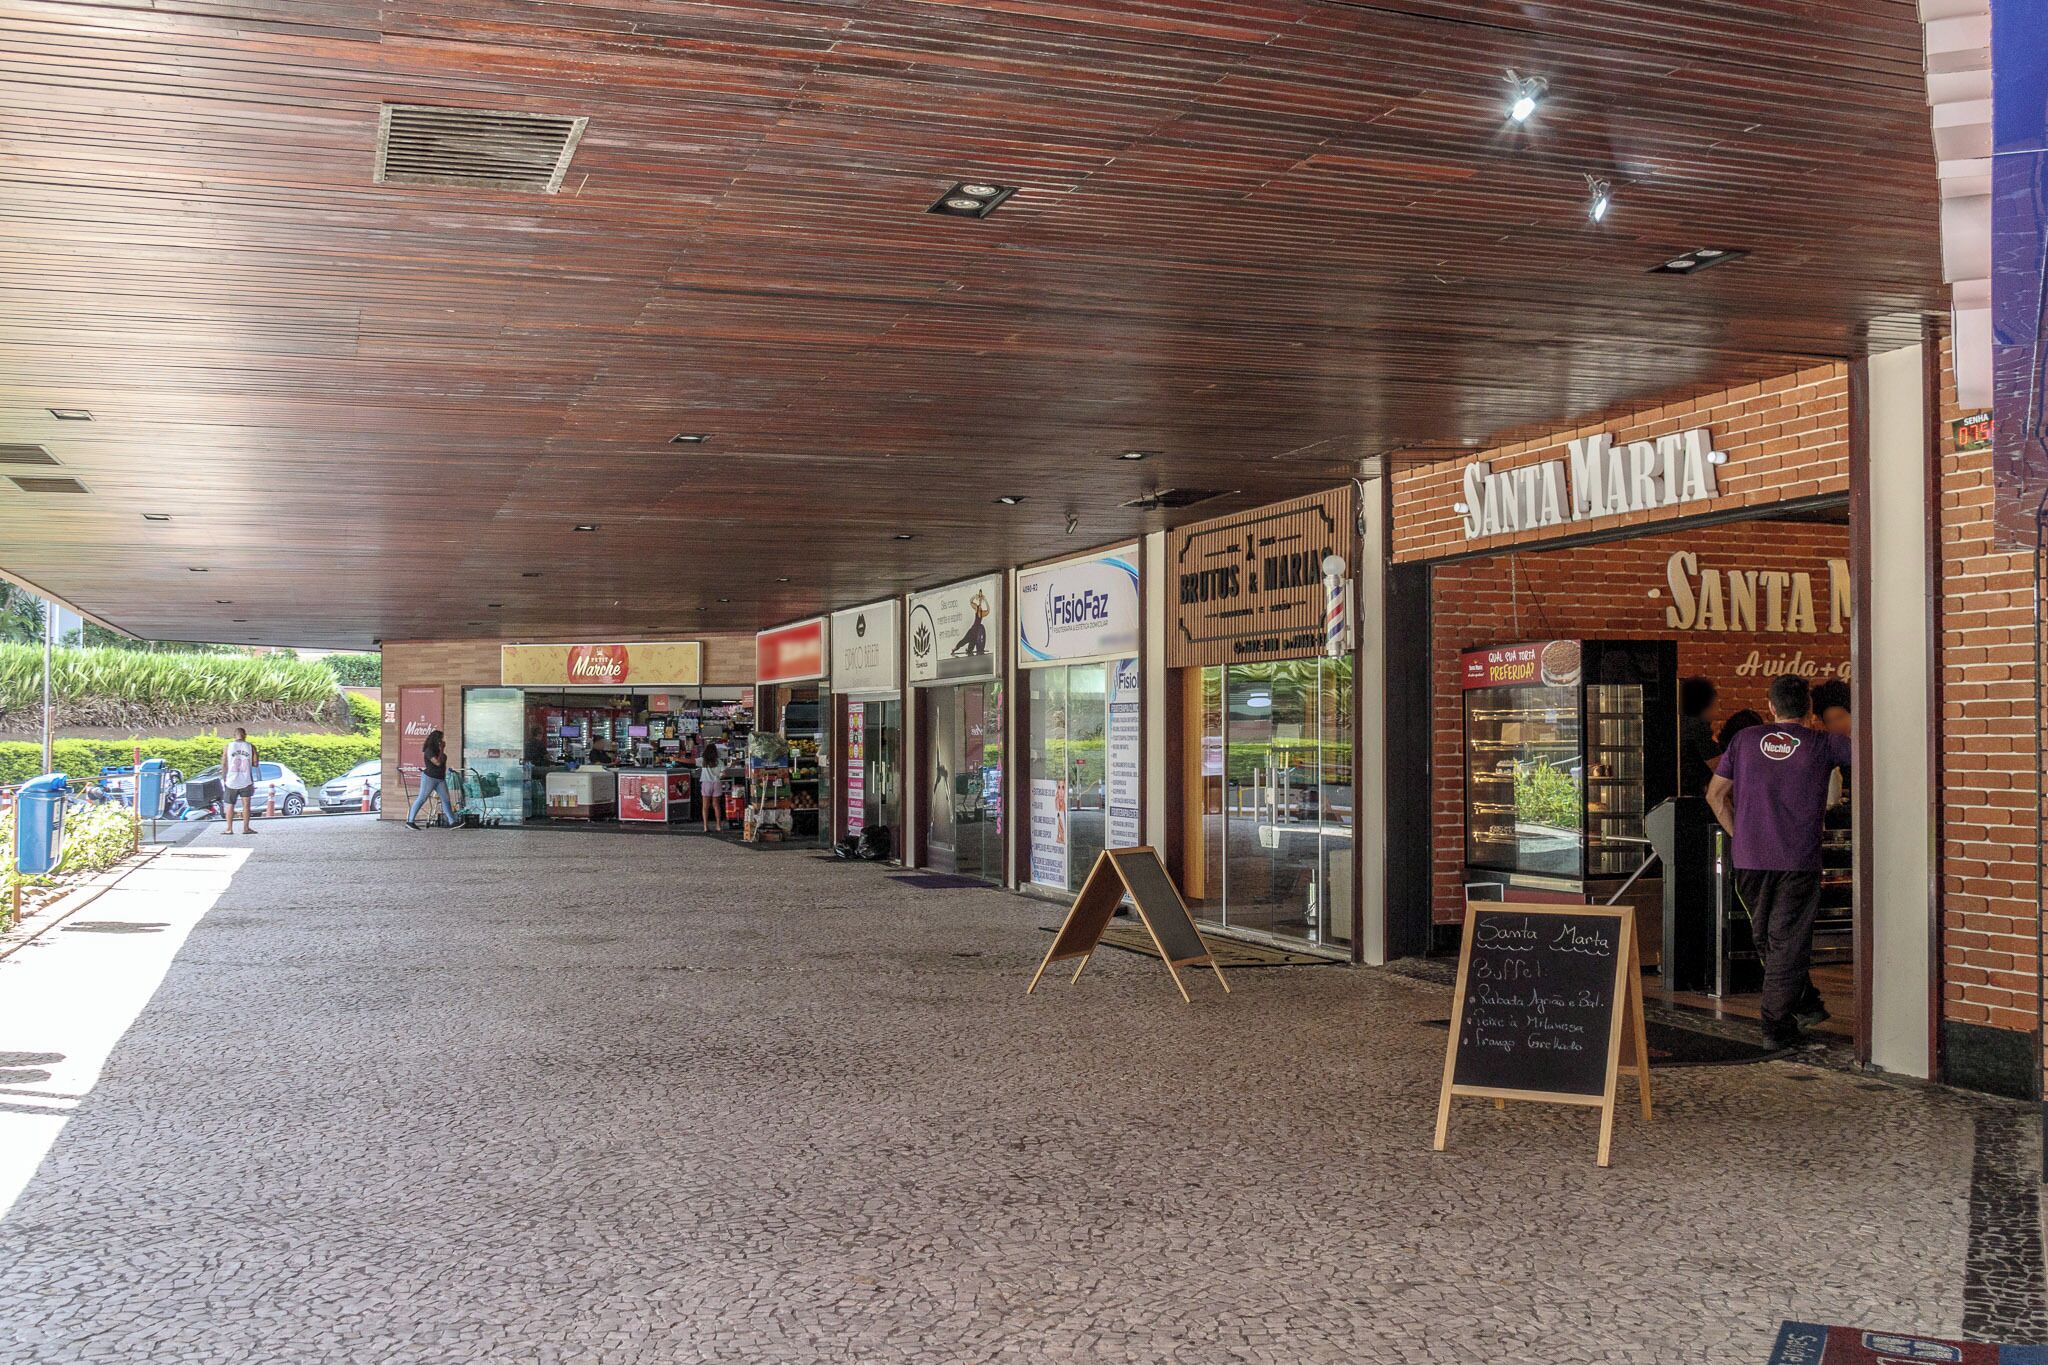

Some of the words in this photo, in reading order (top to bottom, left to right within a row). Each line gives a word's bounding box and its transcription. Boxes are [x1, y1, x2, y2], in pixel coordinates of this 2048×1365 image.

[1964, 413, 1990, 426] SENHA
[1464, 460, 1573, 541] SANTA
[1568, 428, 1719, 521] MARTA
[1180, 564, 1240, 605] BRUTUS
[1248, 571, 1258, 594] &
[1666, 550, 1818, 634] SANTA
[1054, 590, 1108, 625] FisioFaz
[572, 655, 623, 677] Marché
[1488, 651, 1503, 663] QUAL
[1505, 651, 1517, 662] SUA
[1519, 648, 1536, 661] TORTA
[1489, 662, 1535, 681] PREFERIDA?
[1477, 917, 1538, 941] Santa
[1552, 923, 1609, 948] Marta
